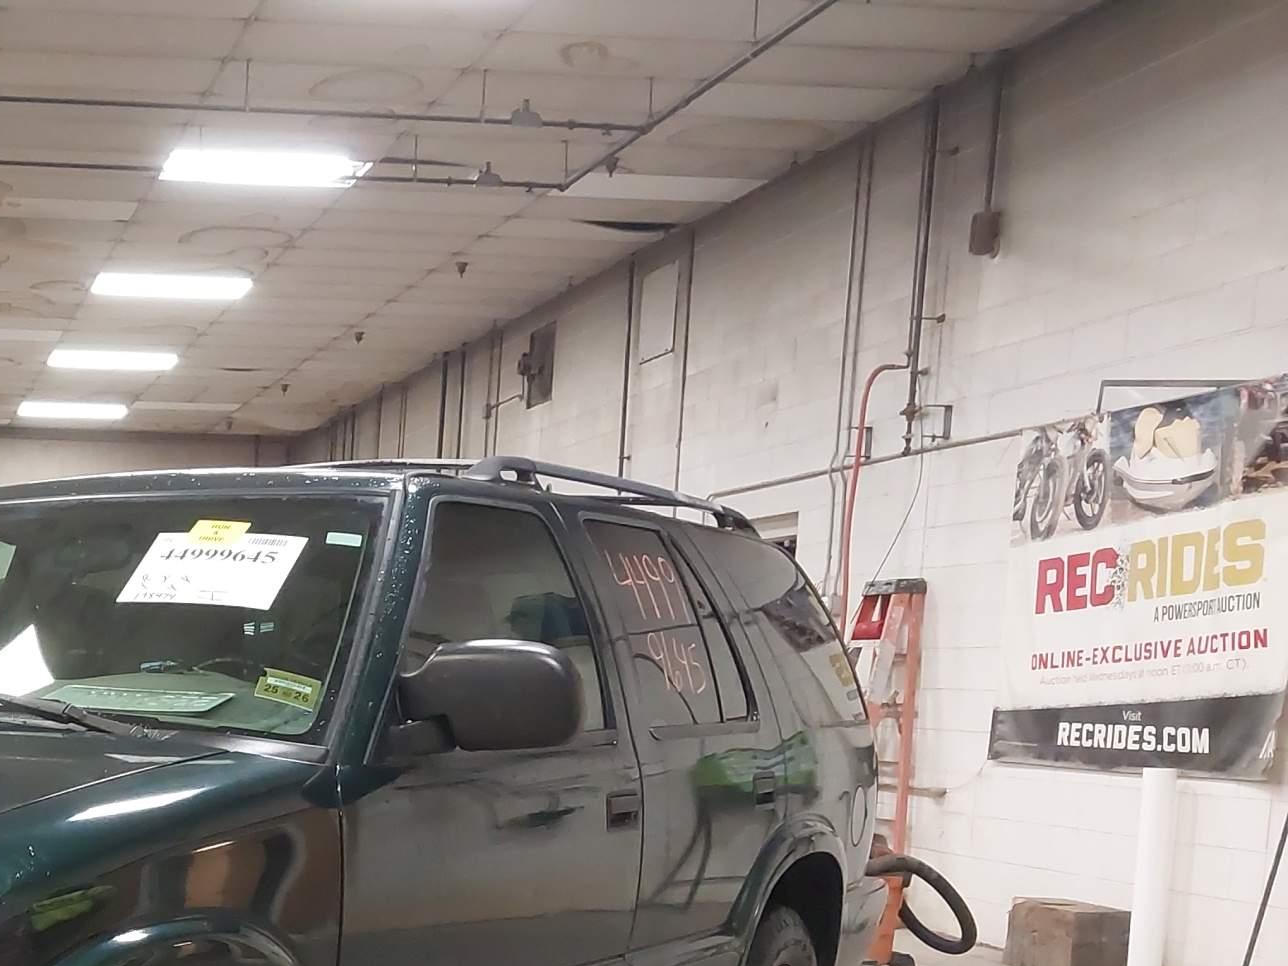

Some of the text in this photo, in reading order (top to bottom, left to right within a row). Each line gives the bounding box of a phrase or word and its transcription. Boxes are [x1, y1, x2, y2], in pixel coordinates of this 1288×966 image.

[160, 548, 279, 564] 44999645
[1035, 518, 1267, 615] REC RIDES
[1153, 606, 1160, 623] A
[1217, 592, 1261, 614] AUCTION
[1030, 638, 1183, 671] ONLINE-EXCLUSIVE
[1186, 628, 1268, 657] AUCTION
[263, 683, 280, 695] 25
[293, 691, 311, 703] 26
[1122, 710, 1143, 722] Visit
[1056, 721, 1211, 754] RECRIDES.COM
